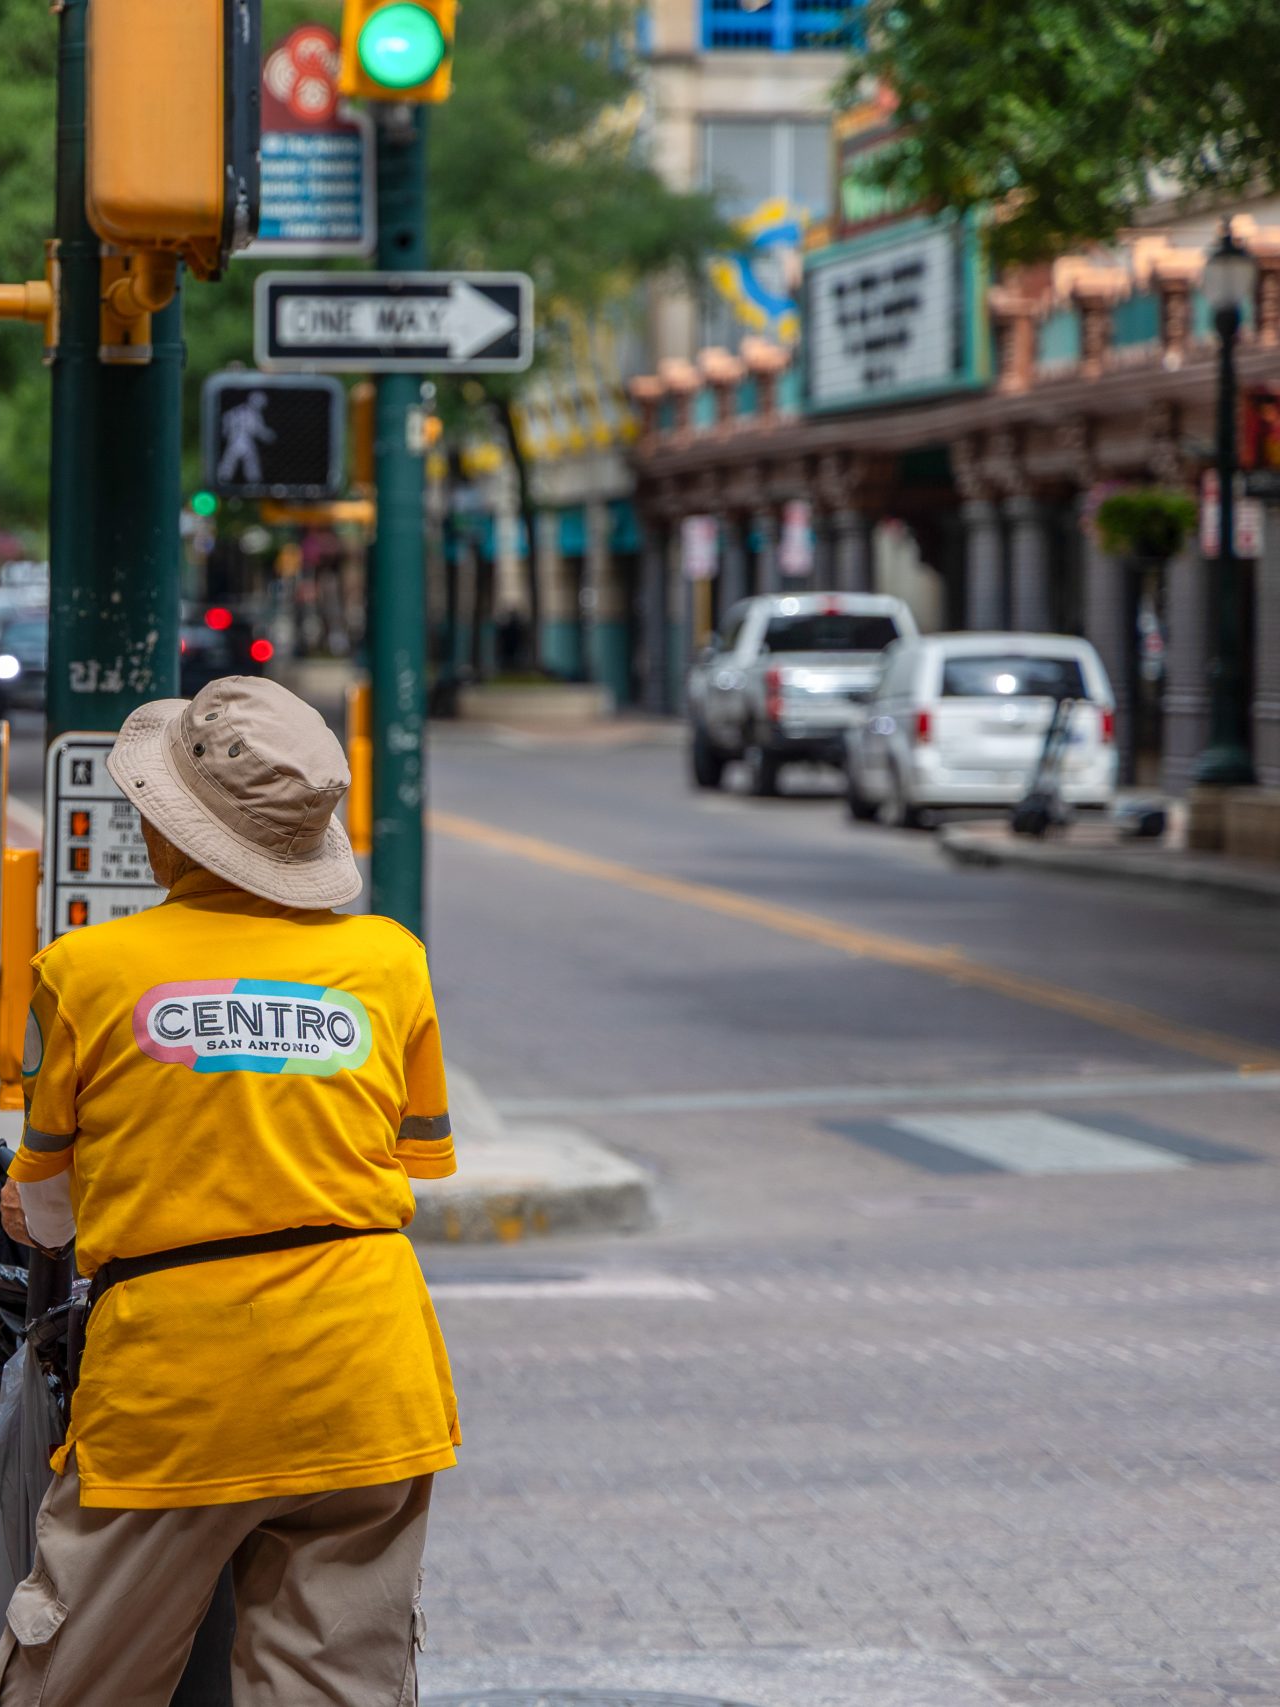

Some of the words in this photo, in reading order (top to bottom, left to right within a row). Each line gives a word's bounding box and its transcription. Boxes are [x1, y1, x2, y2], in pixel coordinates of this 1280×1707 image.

[292, 300, 352, 335] ONE
[376, 300, 446, 335] WAY
[154, 1000, 355, 1047] CENTRO
[207, 1040, 242, 1051] SAN
[248, 1040, 320, 1053] ANTONIO
